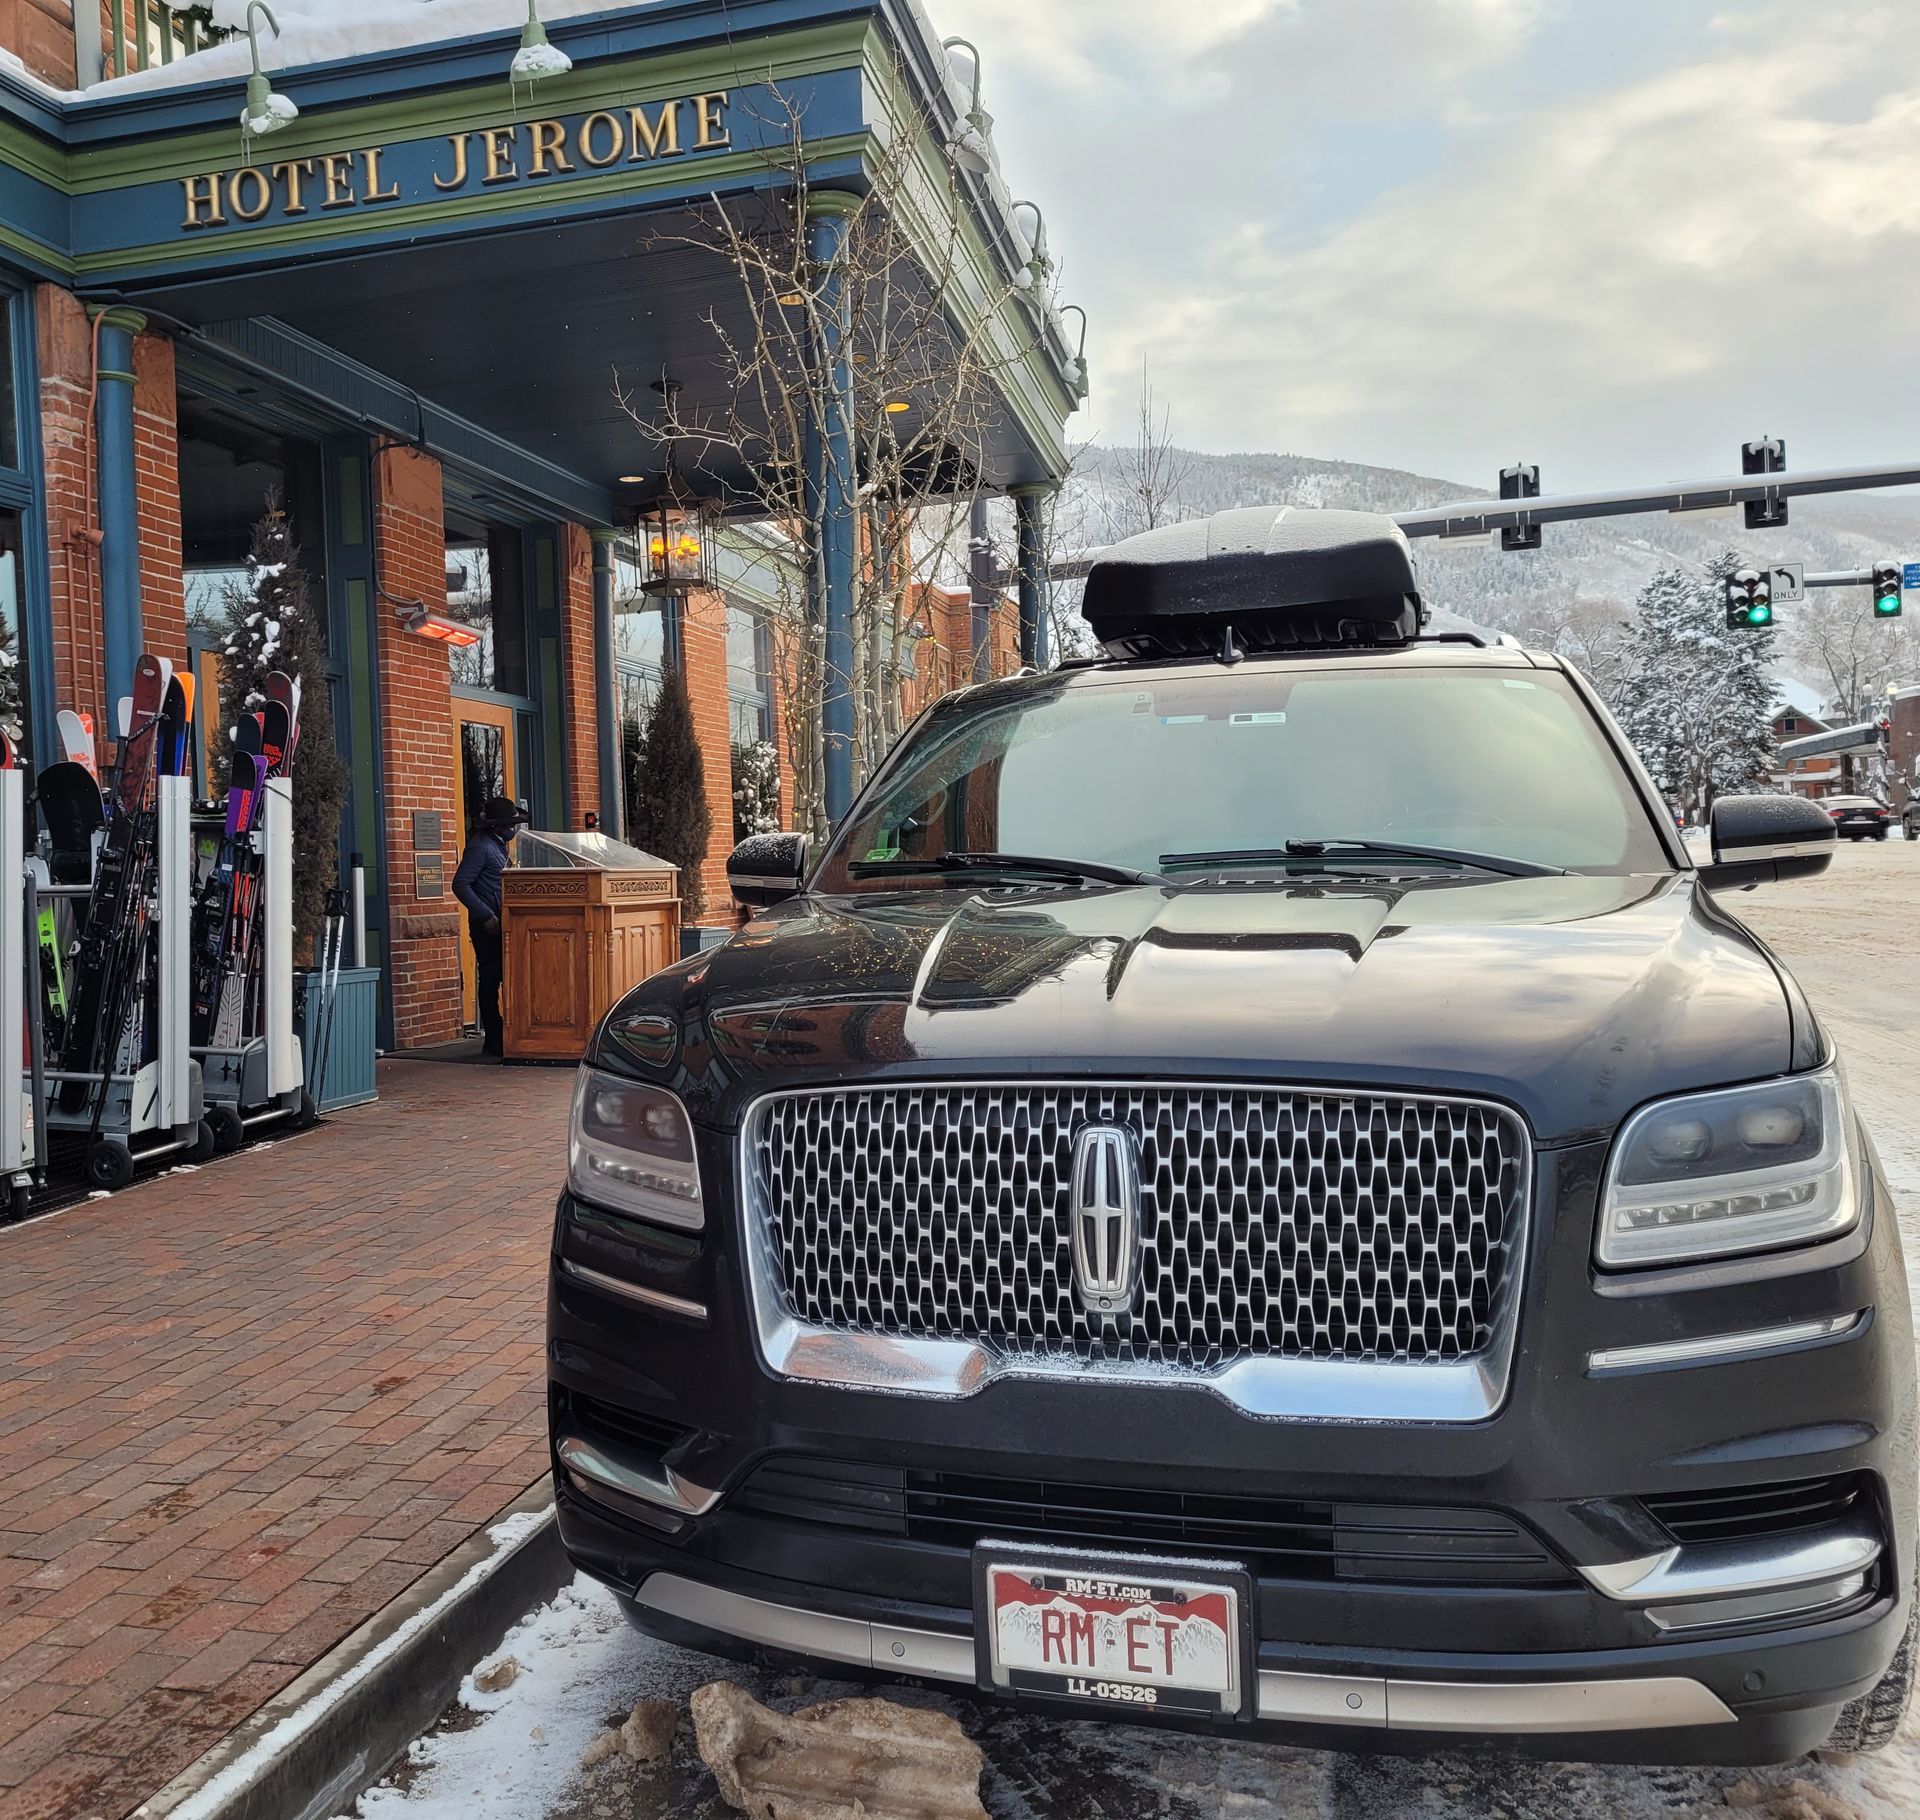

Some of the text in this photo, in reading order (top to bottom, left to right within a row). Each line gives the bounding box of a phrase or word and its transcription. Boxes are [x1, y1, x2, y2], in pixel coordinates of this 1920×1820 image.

[179, 91, 731, 231] HOTEL JEROME
[1773, 590, 1799, 600] ONLY
[1065, 1578, 1152, 1600] RM-ET.COM
[1067, 1678, 1157, 1704] LL-03526
